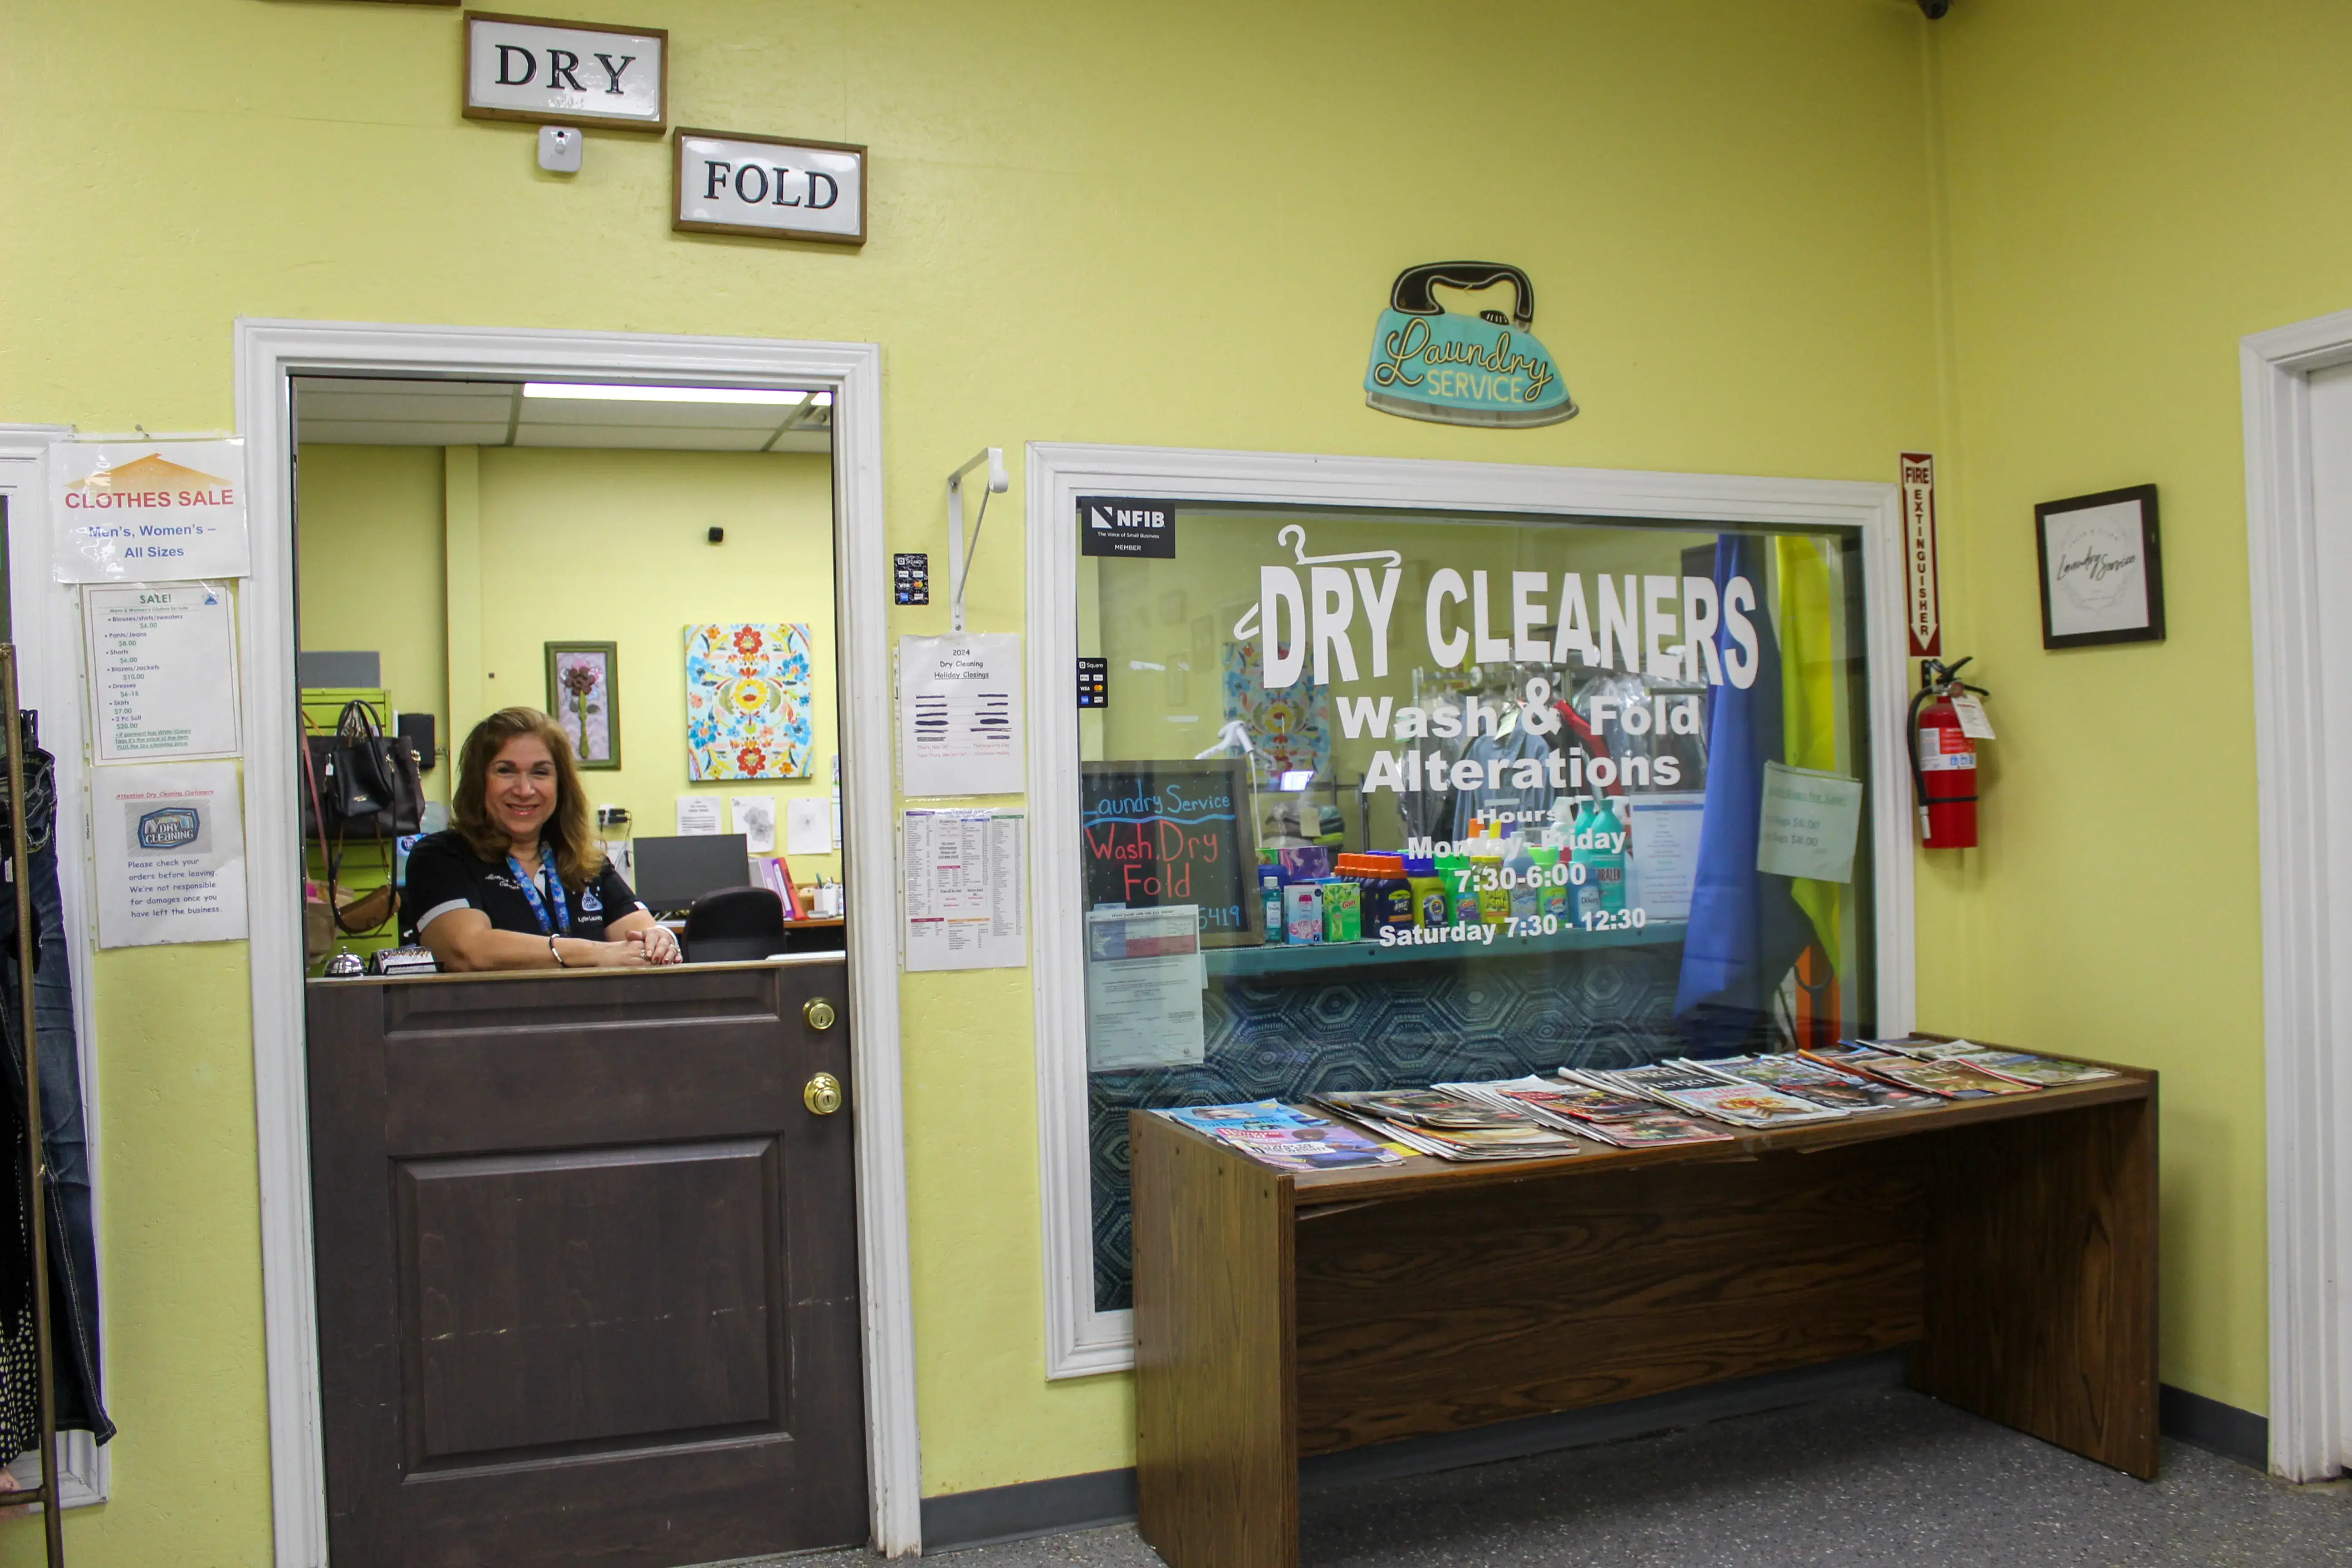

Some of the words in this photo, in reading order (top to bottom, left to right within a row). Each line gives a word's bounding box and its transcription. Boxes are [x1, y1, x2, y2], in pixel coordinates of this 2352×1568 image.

[495, 44, 636, 94] DRY
[703, 160, 838, 210] FOLD
[1374, 317, 1553, 402] Laundry
[1427, 370, 1524, 403] SERVICE
[1905, 467, 1929, 485] FIRE
[65, 491, 171, 509] CLOTHES
[178, 490, 234, 507] SALE
[1117, 510, 1165, 528] NFIB
[89, 526, 135, 538] Men's,
[140, 524, 203, 536] Women's
[125, 548, 142, 558] All
[148, 546, 184, 557] Sizes
[1914, 489, 1929, 636] EXTINGUISHER
[2056, 545, 2101, 581] Laundry
[140, 594, 172, 604] SALE!
[1261, 565, 1401, 688] DRY
[1426, 568, 1759, 690] CLEANERS
[1336, 695, 1497, 739] Wash
[1521, 677, 1564, 735] &
[1590, 695, 1699, 735] Fold
[1362, 747, 1681, 793] Alterations
[1166, 784, 1230, 813] Service
[1477, 809, 1557, 824] Hours
[159, 823, 180, 833] DRY
[1159, 819, 1218, 862] Dry
[1542, 828, 1626, 854] Friday
[182, 859, 199, 867] your
[189, 870, 217, 878] leaving.
[1123, 862, 1190, 901] Fold
[1455, 863, 1586, 893] 7:30-6:00
[1597, 868, 1621, 881] ORALEN
[173, 881, 216, 892] responsible
[147, 897, 180, 905] damages
[188, 906, 222, 914] business.
[1343, 900, 1355, 908] Gain
[1379, 921, 1496, 947] Saturday
[1504, 915, 1558, 939] 7:30
[1581, 908, 1646, 932] 12:30
